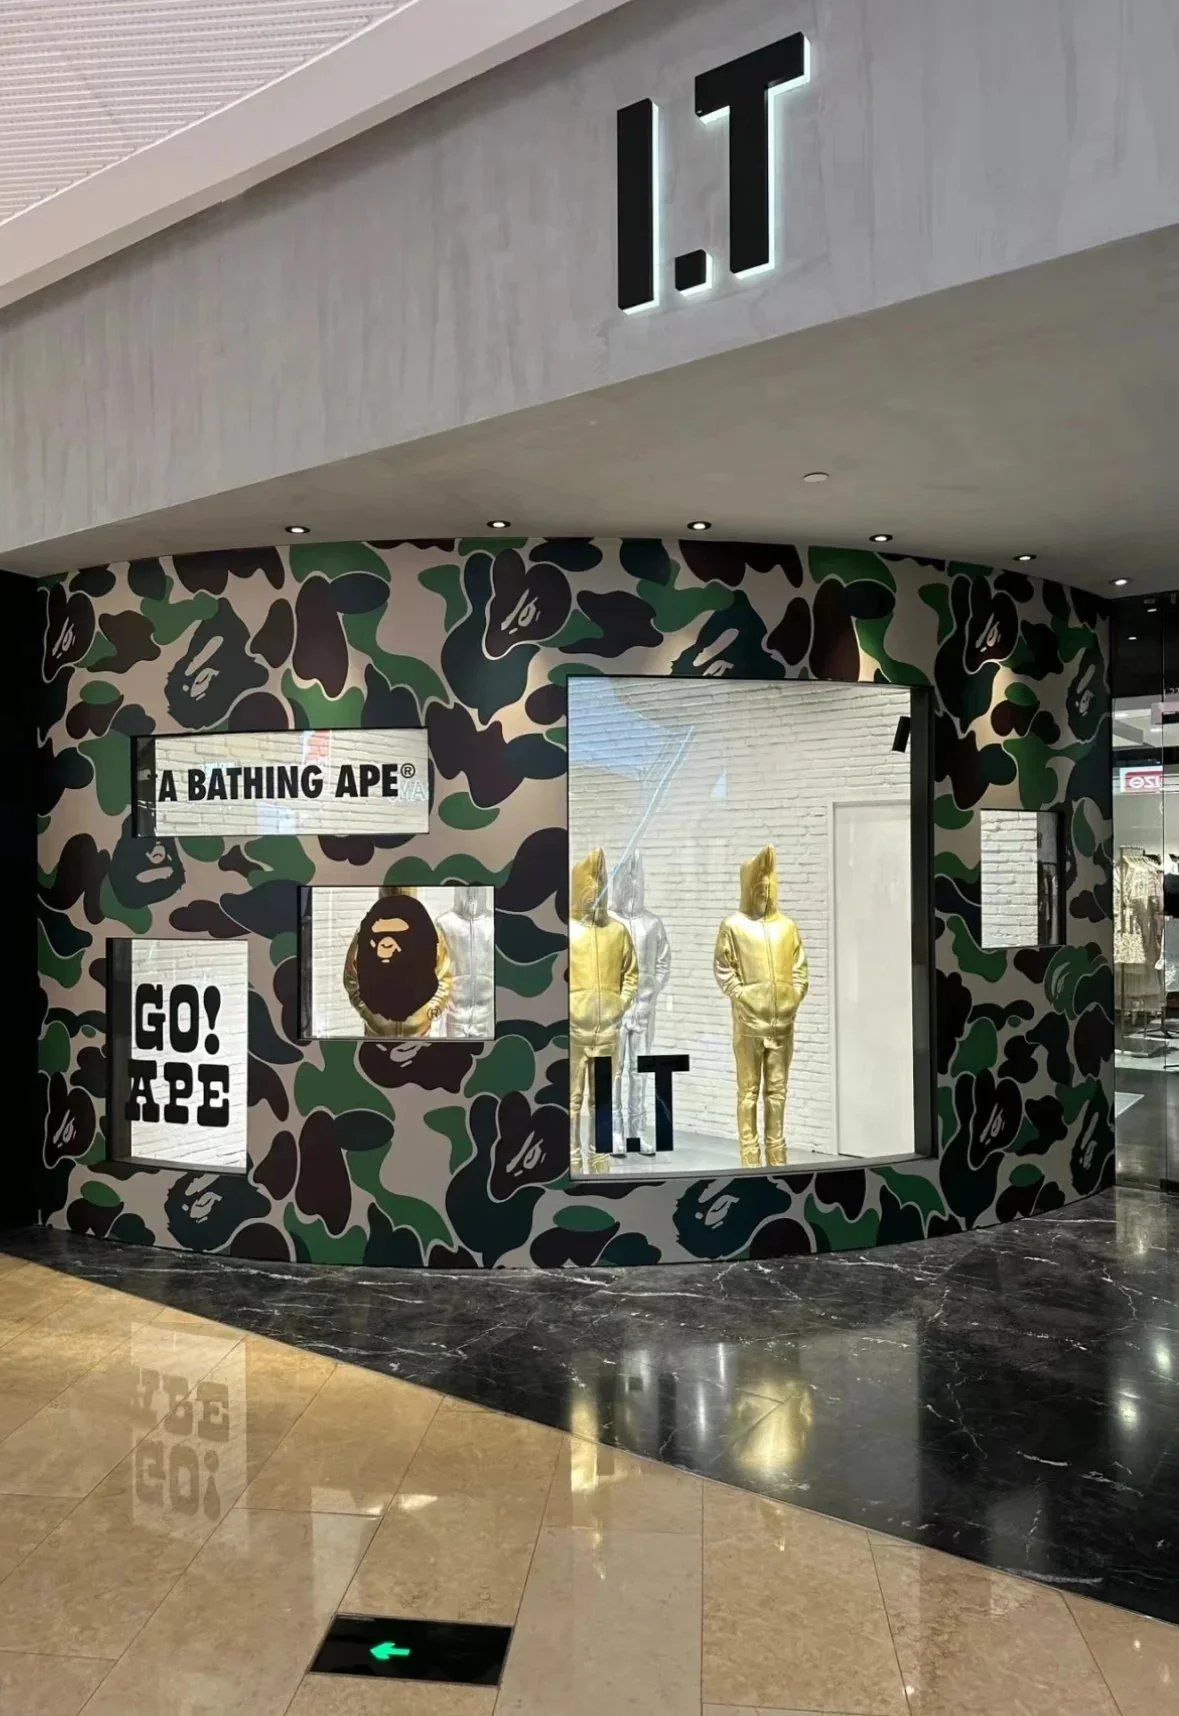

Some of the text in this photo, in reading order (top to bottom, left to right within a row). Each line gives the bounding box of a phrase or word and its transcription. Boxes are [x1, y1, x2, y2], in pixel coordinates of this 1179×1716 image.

[617, 31, 808, 312] I.T
[158, 770, 177, 802] A
[188, 764, 323, 802] BATHING
[135, 983, 221, 1055] GO!
[125, 1059, 230, 1128] APE
[594, 1054, 690, 1153] I.T
